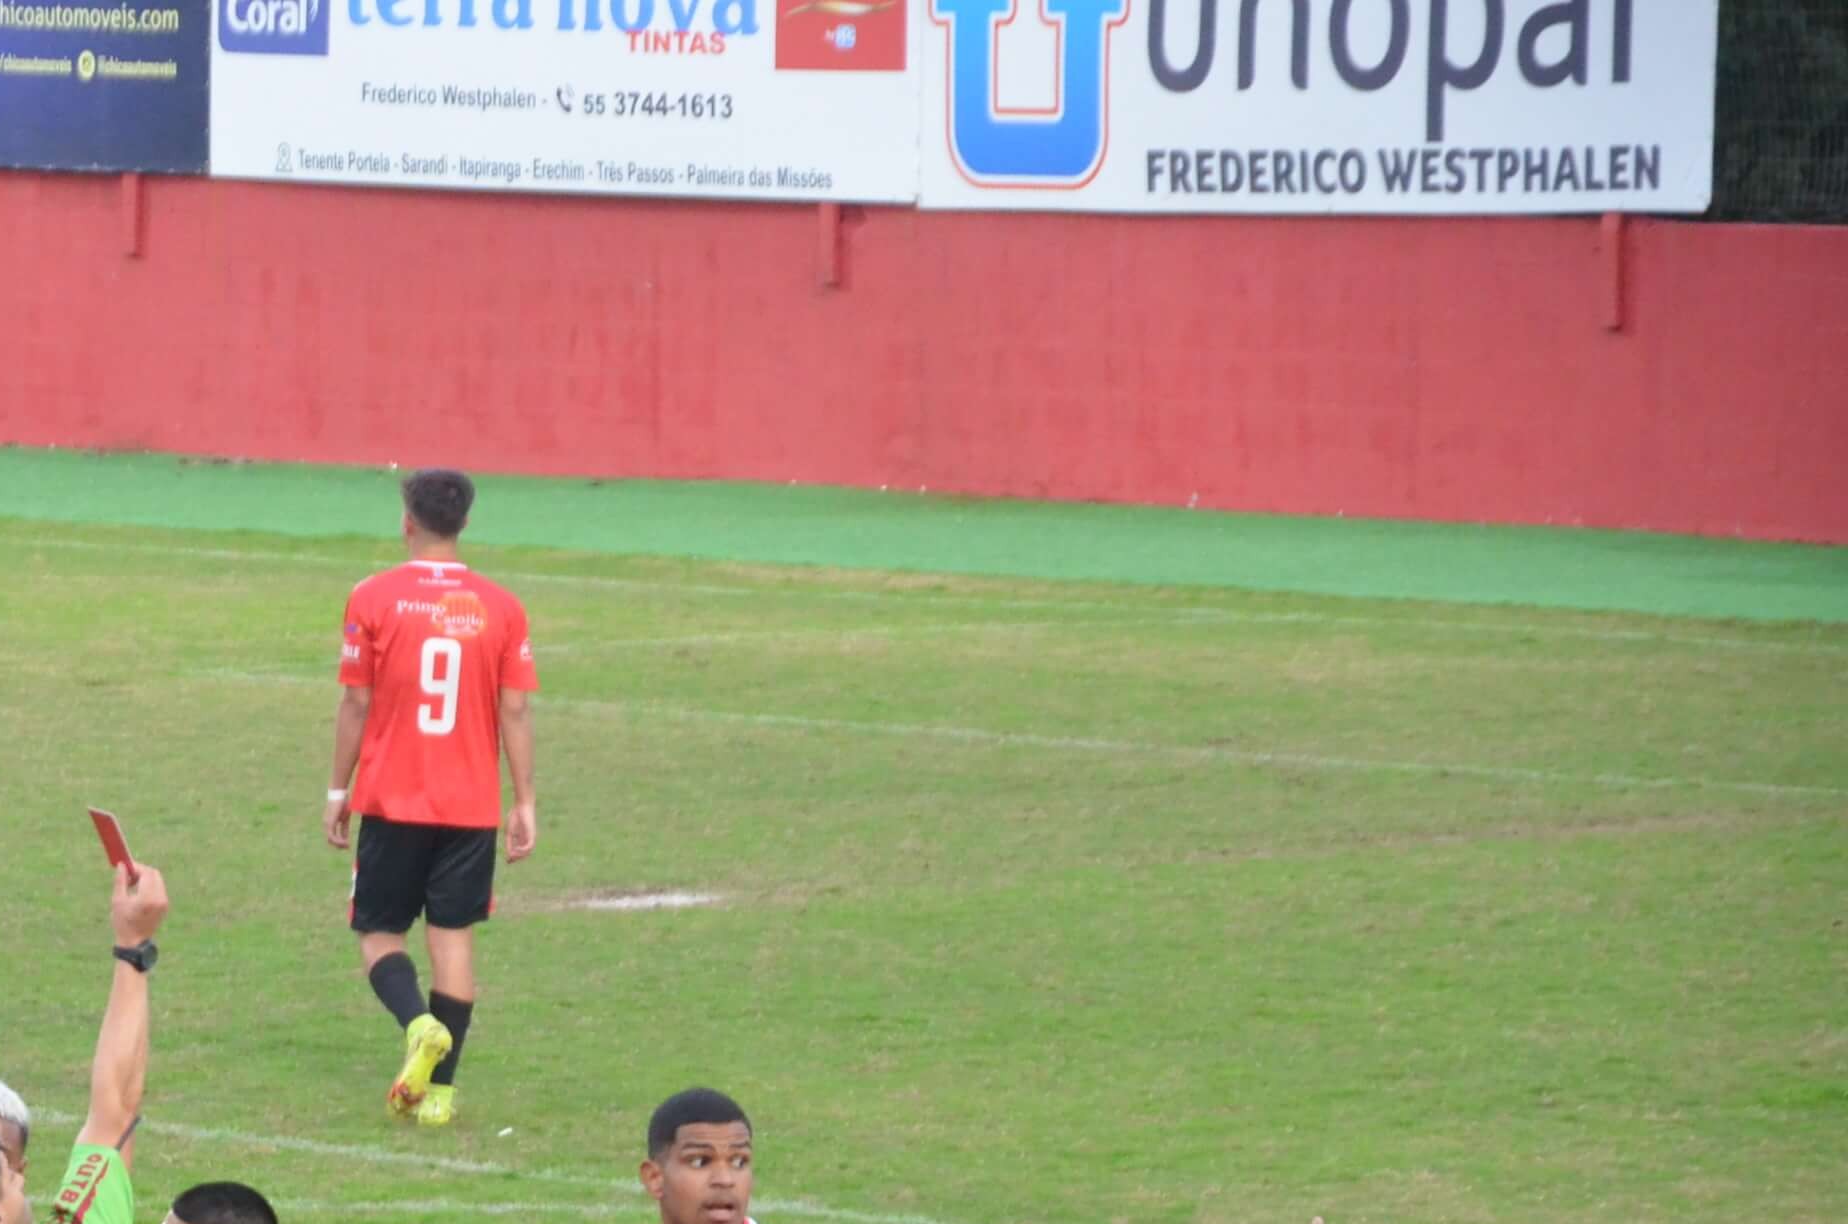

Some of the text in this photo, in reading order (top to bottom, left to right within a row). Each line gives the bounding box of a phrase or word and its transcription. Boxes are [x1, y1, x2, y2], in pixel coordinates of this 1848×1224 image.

[227, 0, 307, 34] Coral
[625, 28, 726, 54] TINTAS
[361, 82, 537, 112] Frederico Westphalen
[583, 91, 734, 120] 55 3744-1613
[298, 149, 344, 172] Tenente
[348, 151, 390, 174] Portela
[459, 155, 522, 182] Itapiranga
[533, 158, 585, 181] Erechim
[628, 161, 675, 184] Passos
[688, 163, 745, 186] Palmeira
[749, 166, 773, 188] das
[1146, 144, 1661, 195] FREDERICO WESTPHALEN
[396, 599, 447, 615] Primo
[417, 637, 463, 736] 9
